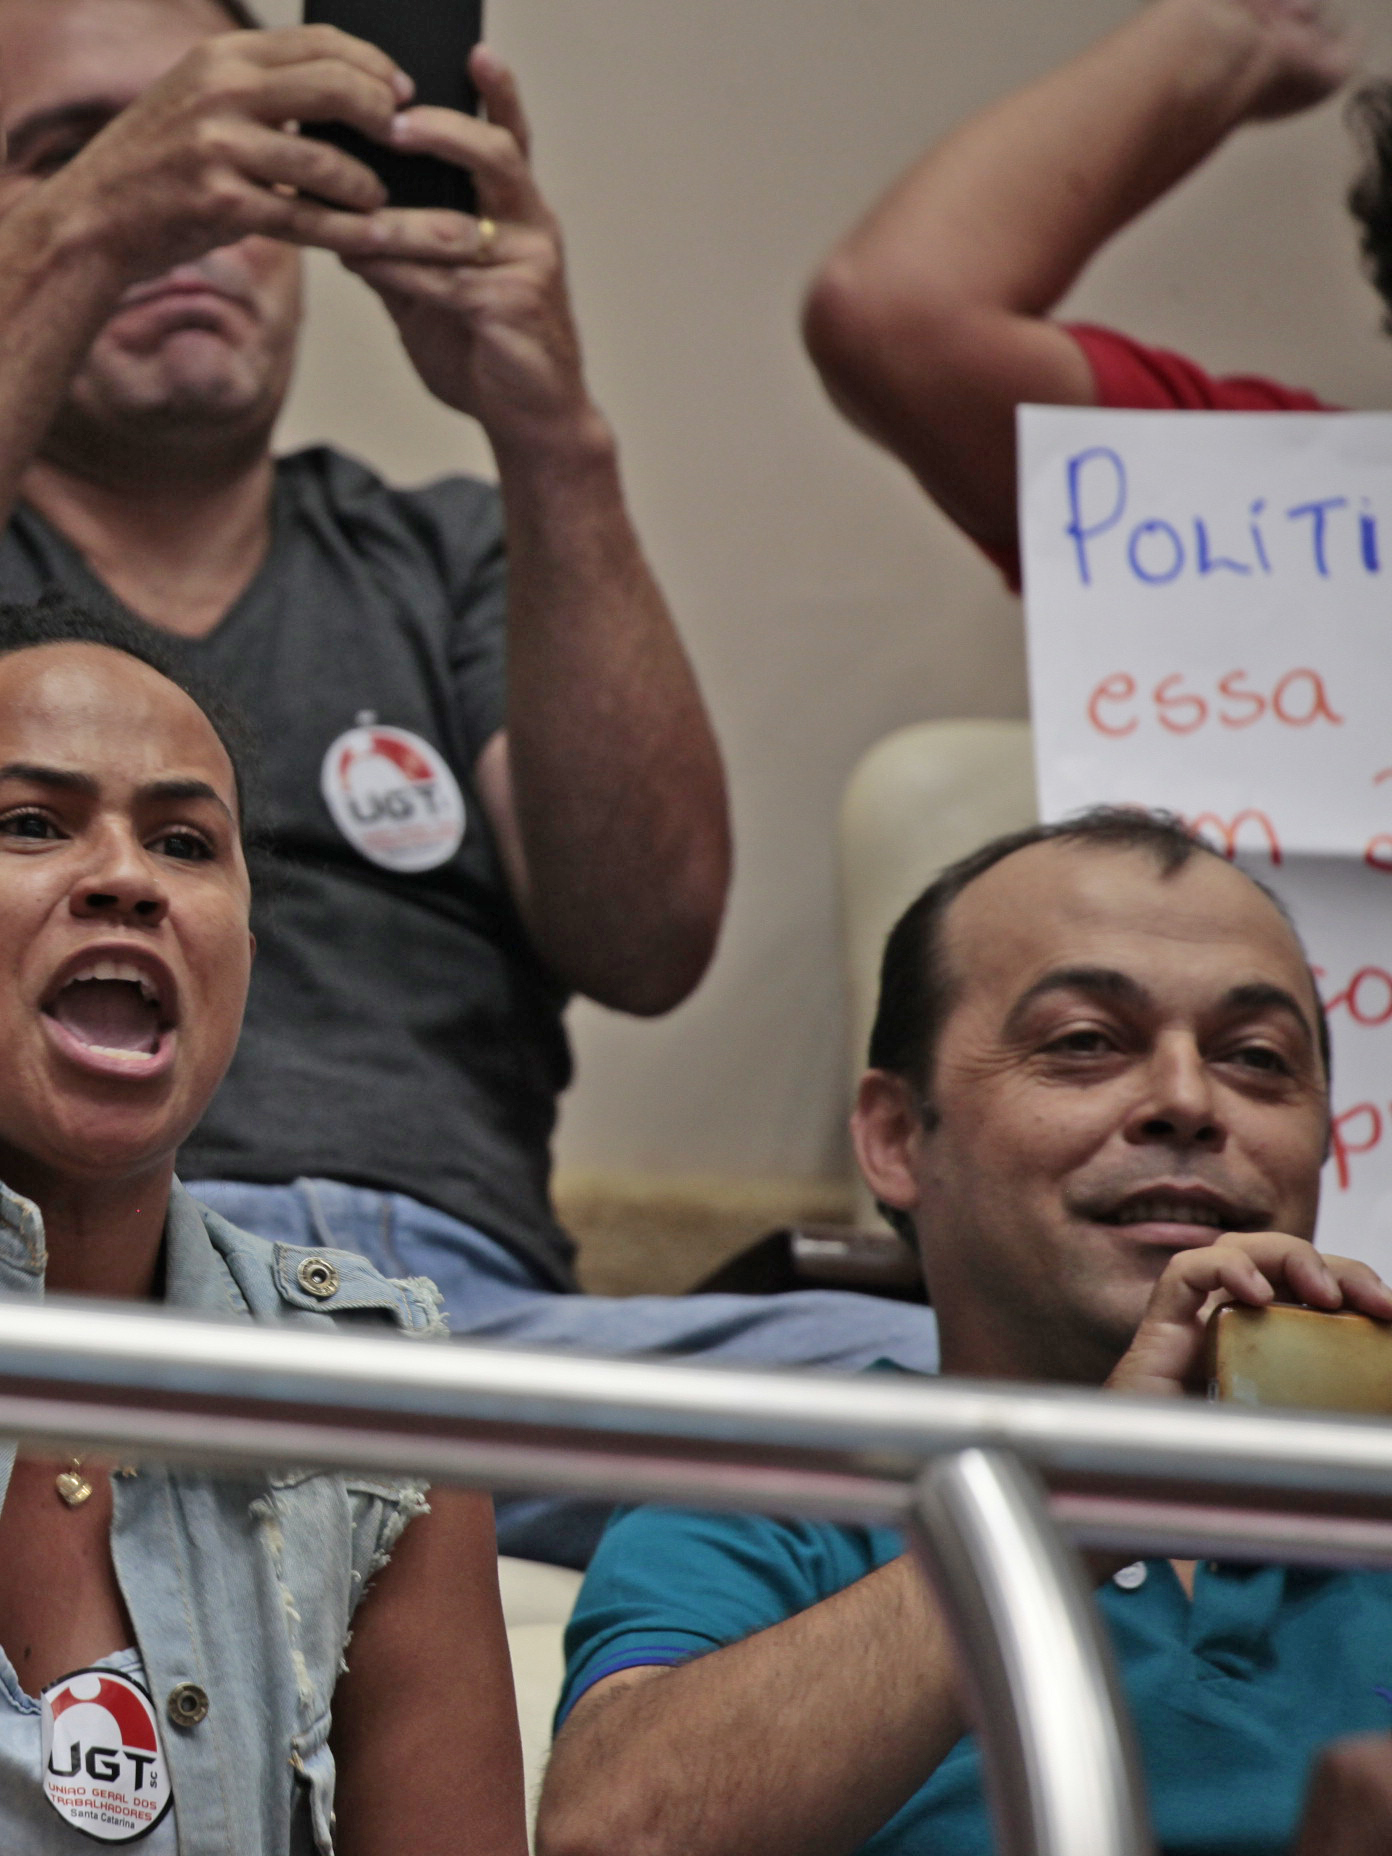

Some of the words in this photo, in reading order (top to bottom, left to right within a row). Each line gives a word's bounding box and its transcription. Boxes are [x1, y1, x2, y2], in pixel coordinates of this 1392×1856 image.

[1087, 667, 1346, 737] essa
[48, 1741, 157, 1792] UGT
[149, 1770, 158, 1789] SC
[49, 1793, 153, 1822] TRABALHADORES
[92, 1788, 129, 1804] GERAL
[133, 1797, 157, 1811] DOS
[70, 1808, 99, 1820] Santa
[100, 1813, 136, 1830] Catarina
